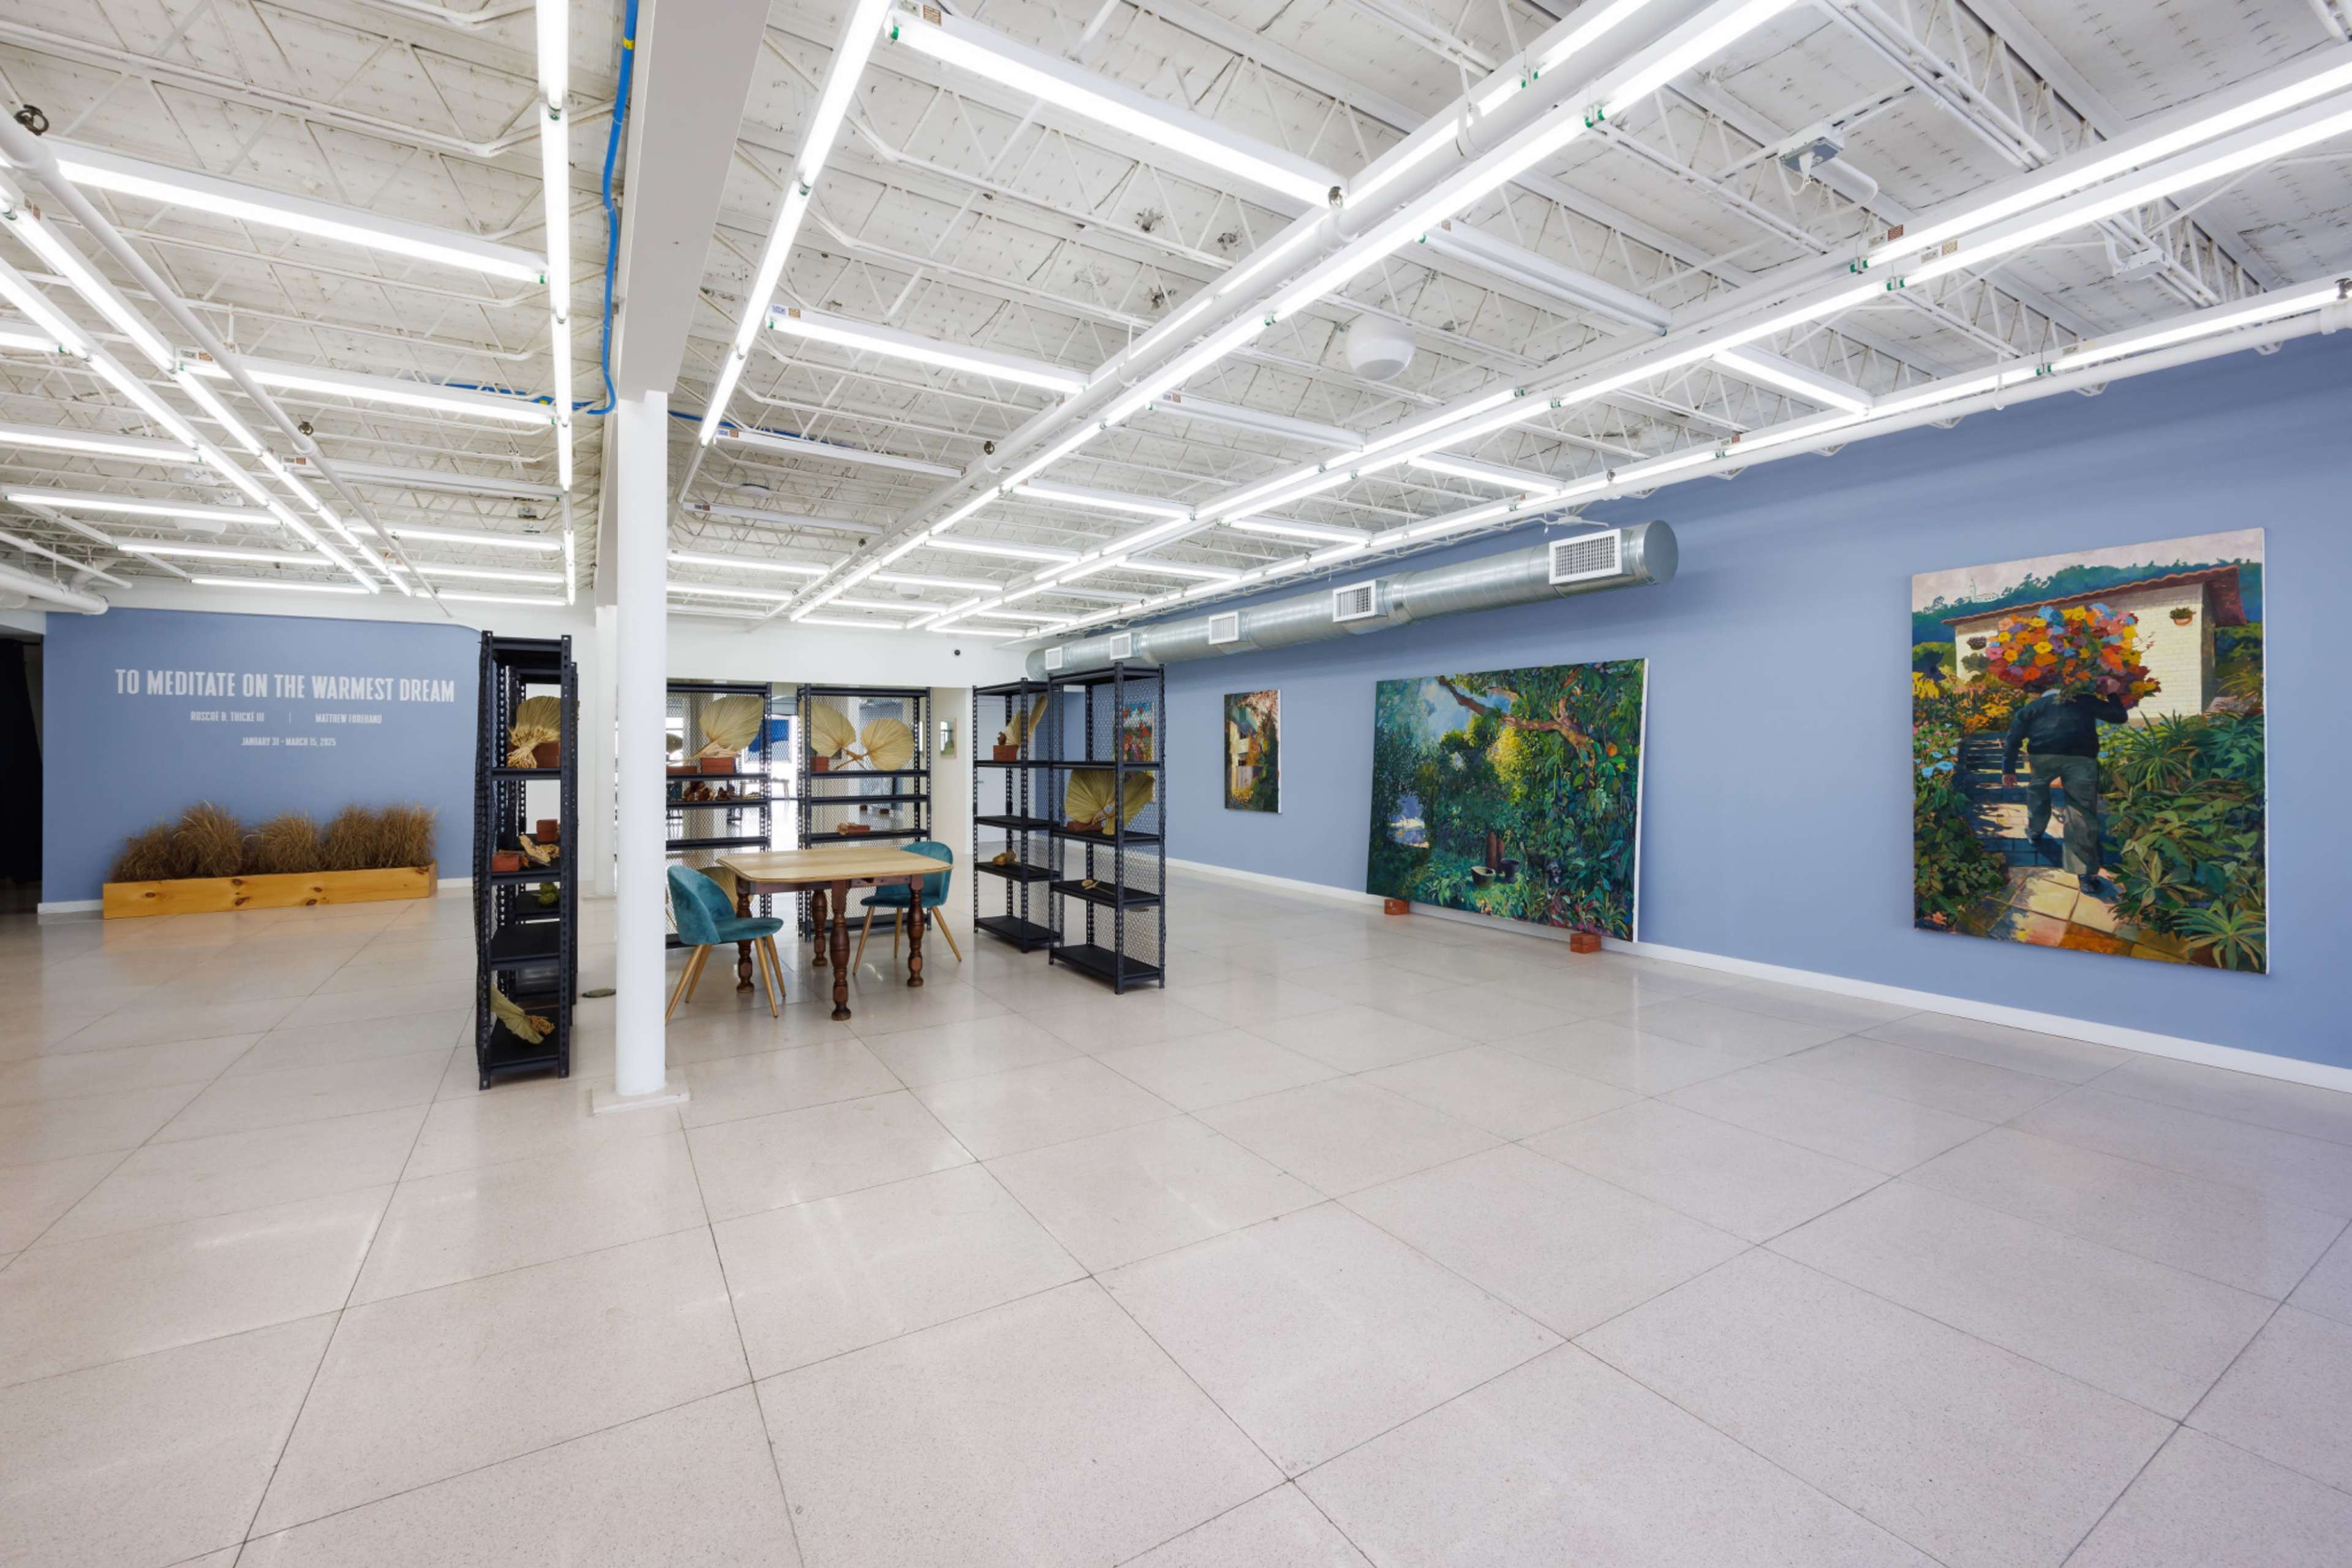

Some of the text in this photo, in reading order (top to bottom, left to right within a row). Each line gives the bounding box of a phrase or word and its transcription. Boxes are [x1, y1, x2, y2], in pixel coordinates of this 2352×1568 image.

[115, 669, 454, 703] TO MEDITATE ON THE WARMEST DREAM
[315, 713, 382, 724] MATTHEW FOREHAND
[241, 736, 271, 746] JANUARY
[272, 736, 280, 746] 31
[285, 737, 309, 746] MARCH
[319, 737, 337, 746] 2025
